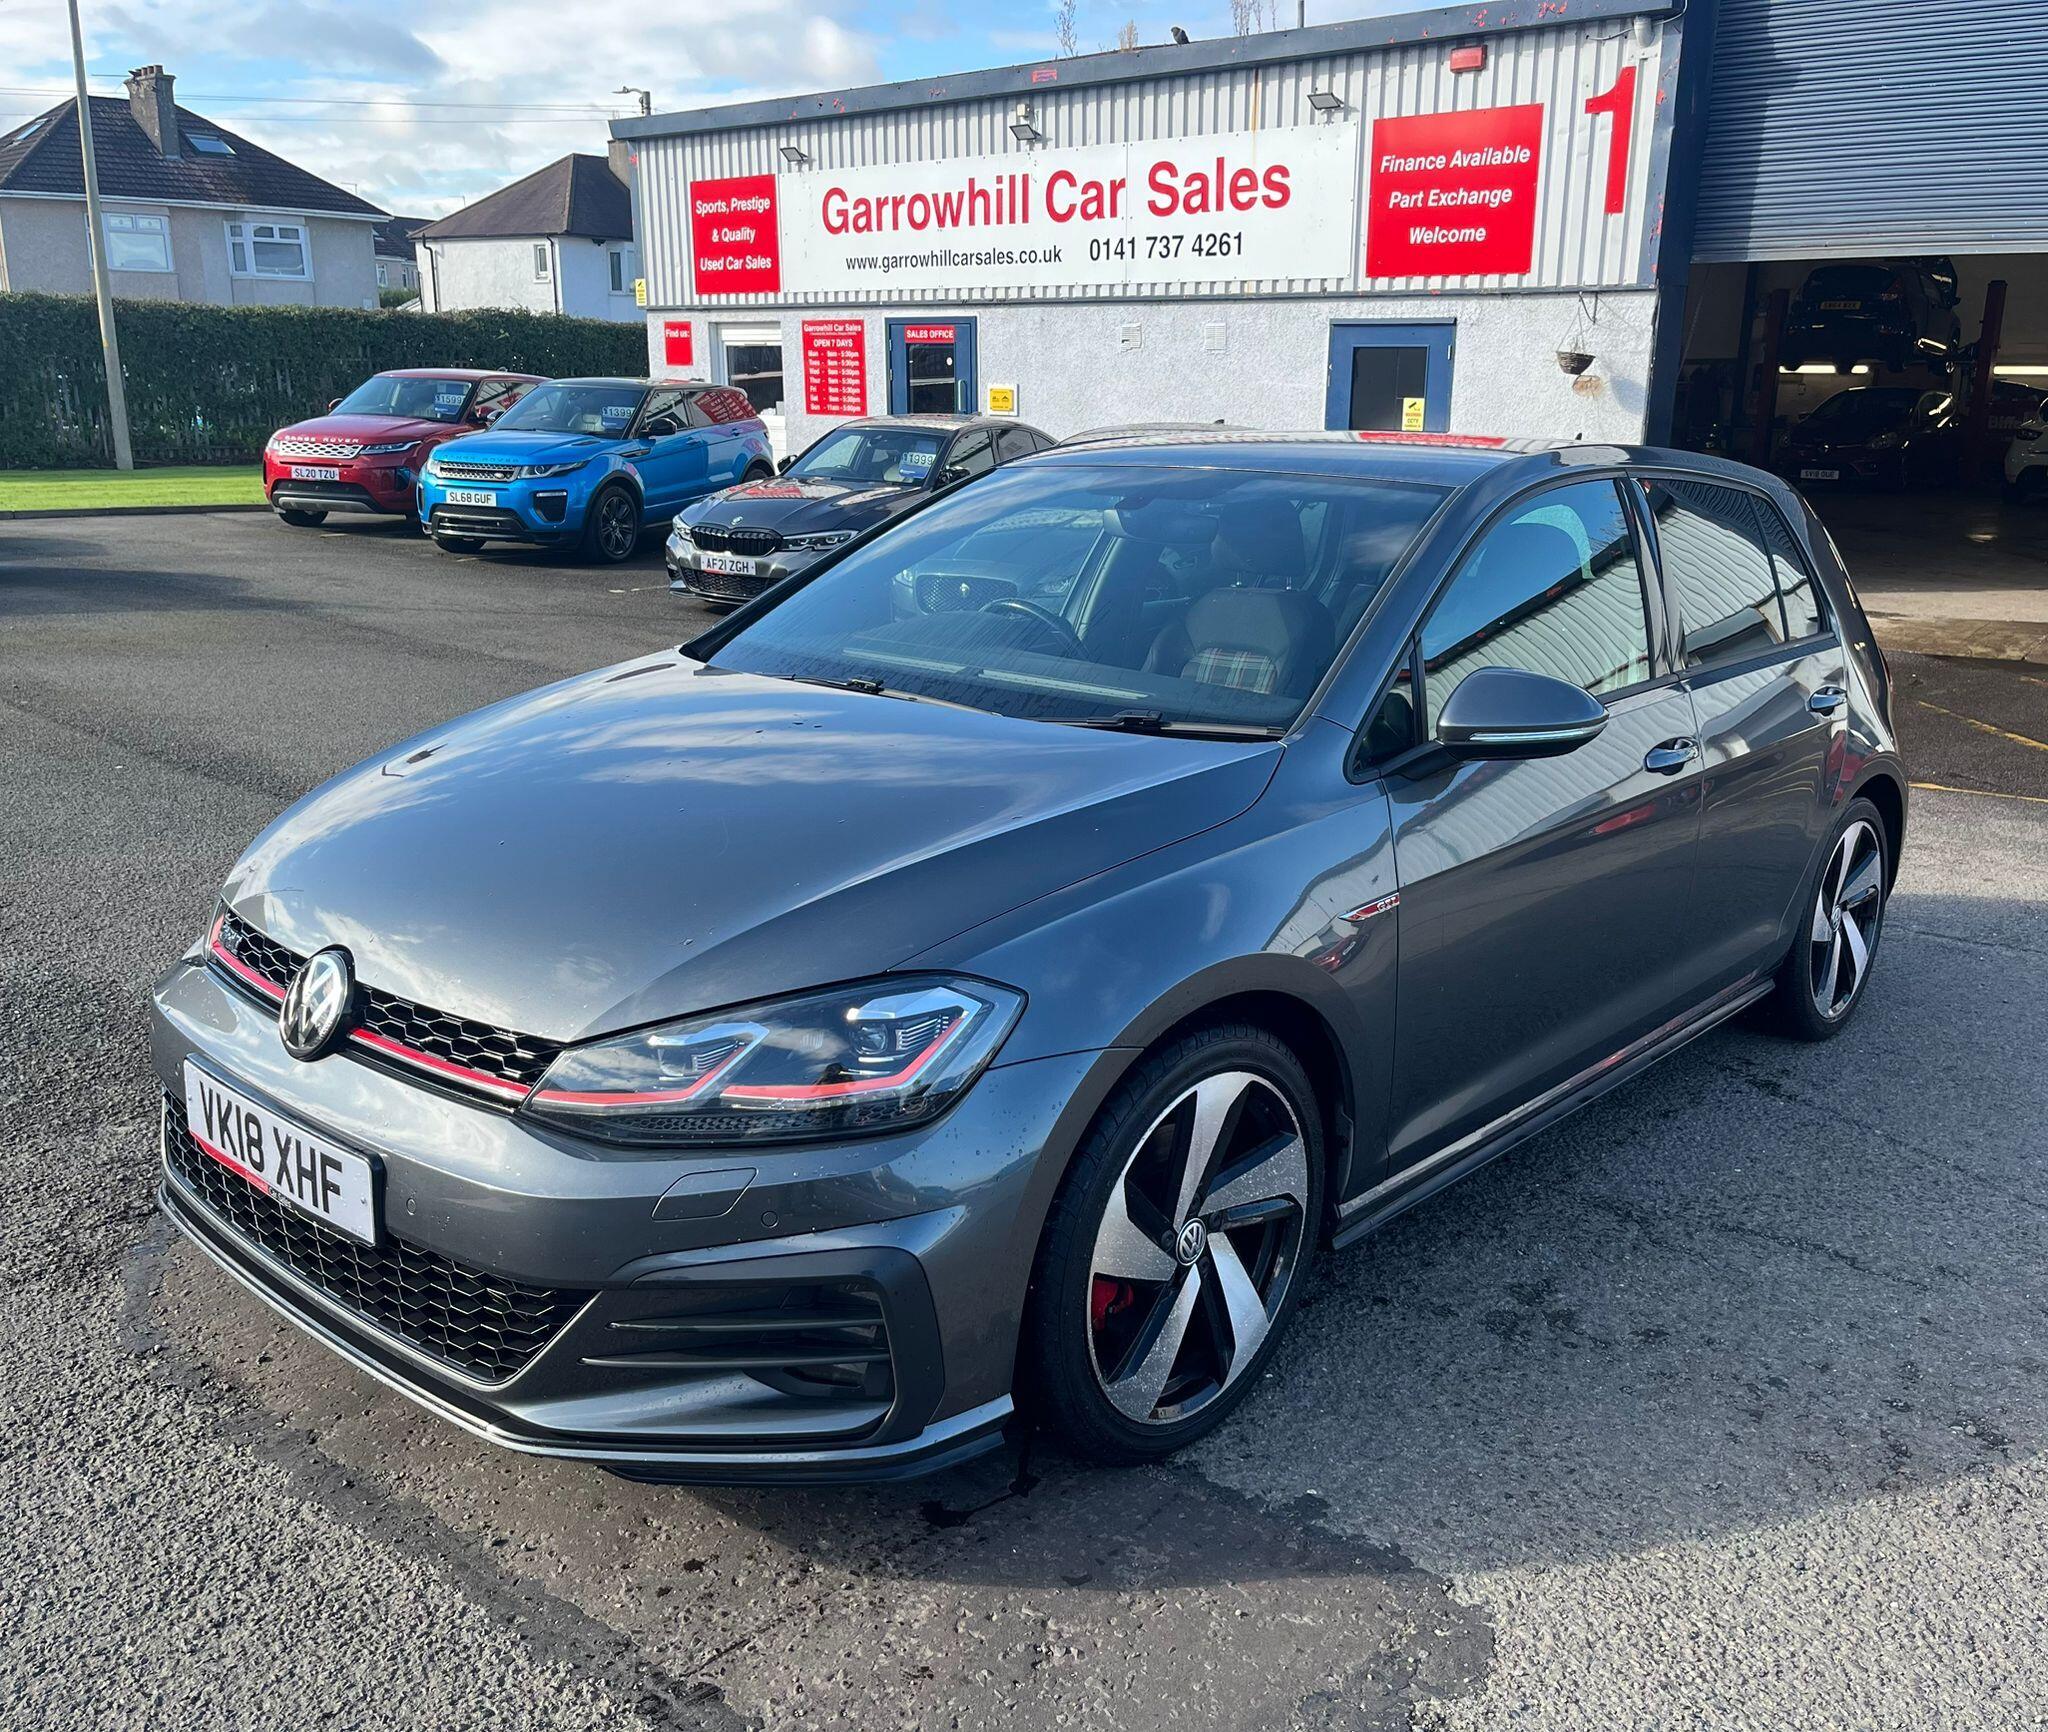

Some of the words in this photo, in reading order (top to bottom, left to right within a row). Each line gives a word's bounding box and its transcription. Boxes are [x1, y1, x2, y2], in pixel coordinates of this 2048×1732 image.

[1584, 65, 1637, 213] 1
[1380, 154, 1446, 173] Finance
[1449, 145, 1531, 168] Available
[822, 173, 1029, 235] Garrowhill
[1046, 170, 1126, 223] Car
[1147, 156, 1291, 218] Sales
[1389, 190, 1424, 209] Part
[1427, 187, 1513, 208] Exchange
[696, 199, 729, 217] Sports,
[731, 196, 770, 213] Prestige
[712, 228, 719, 242] &
[722, 227, 756, 244] Quality
[1409, 226, 1487, 245] Welcome
[1089, 236, 1135, 261] 0141
[1146, 235, 1184, 259] 737
[1191, 231, 1242, 257] 4261
[700, 257, 724, 271] Used
[726, 256, 743, 270] Car
[745, 255, 772, 269] Sales
[846, 245, 1062, 273] www.garrowhillcarsales.co.uk
[665, 329, 679, 338] Find
[834, 323, 845, 332] Car
[845, 323, 862, 331] Sales
[906, 329, 929, 339] SALES
[929, 329, 954, 339] OFFICE
[813, 339, 831, 348] OPEN
[831, 339, 836, 347] 7
[836, 339, 853, 347] DAYS
[435, 395, 462, 405] £1599
[602, 407, 631, 418] £1399
[294, 467, 316, 478] SL20
[318, 469, 336, 479] TZU
[449, 491, 472, 503] SL68
[474, 493, 492, 504] GUF
[706, 557, 727, 571] AF21
[729, 560, 749, 573] ZGH
[199, 1080, 265, 1172] VK18
[272, 1126, 343, 1214] XHF
